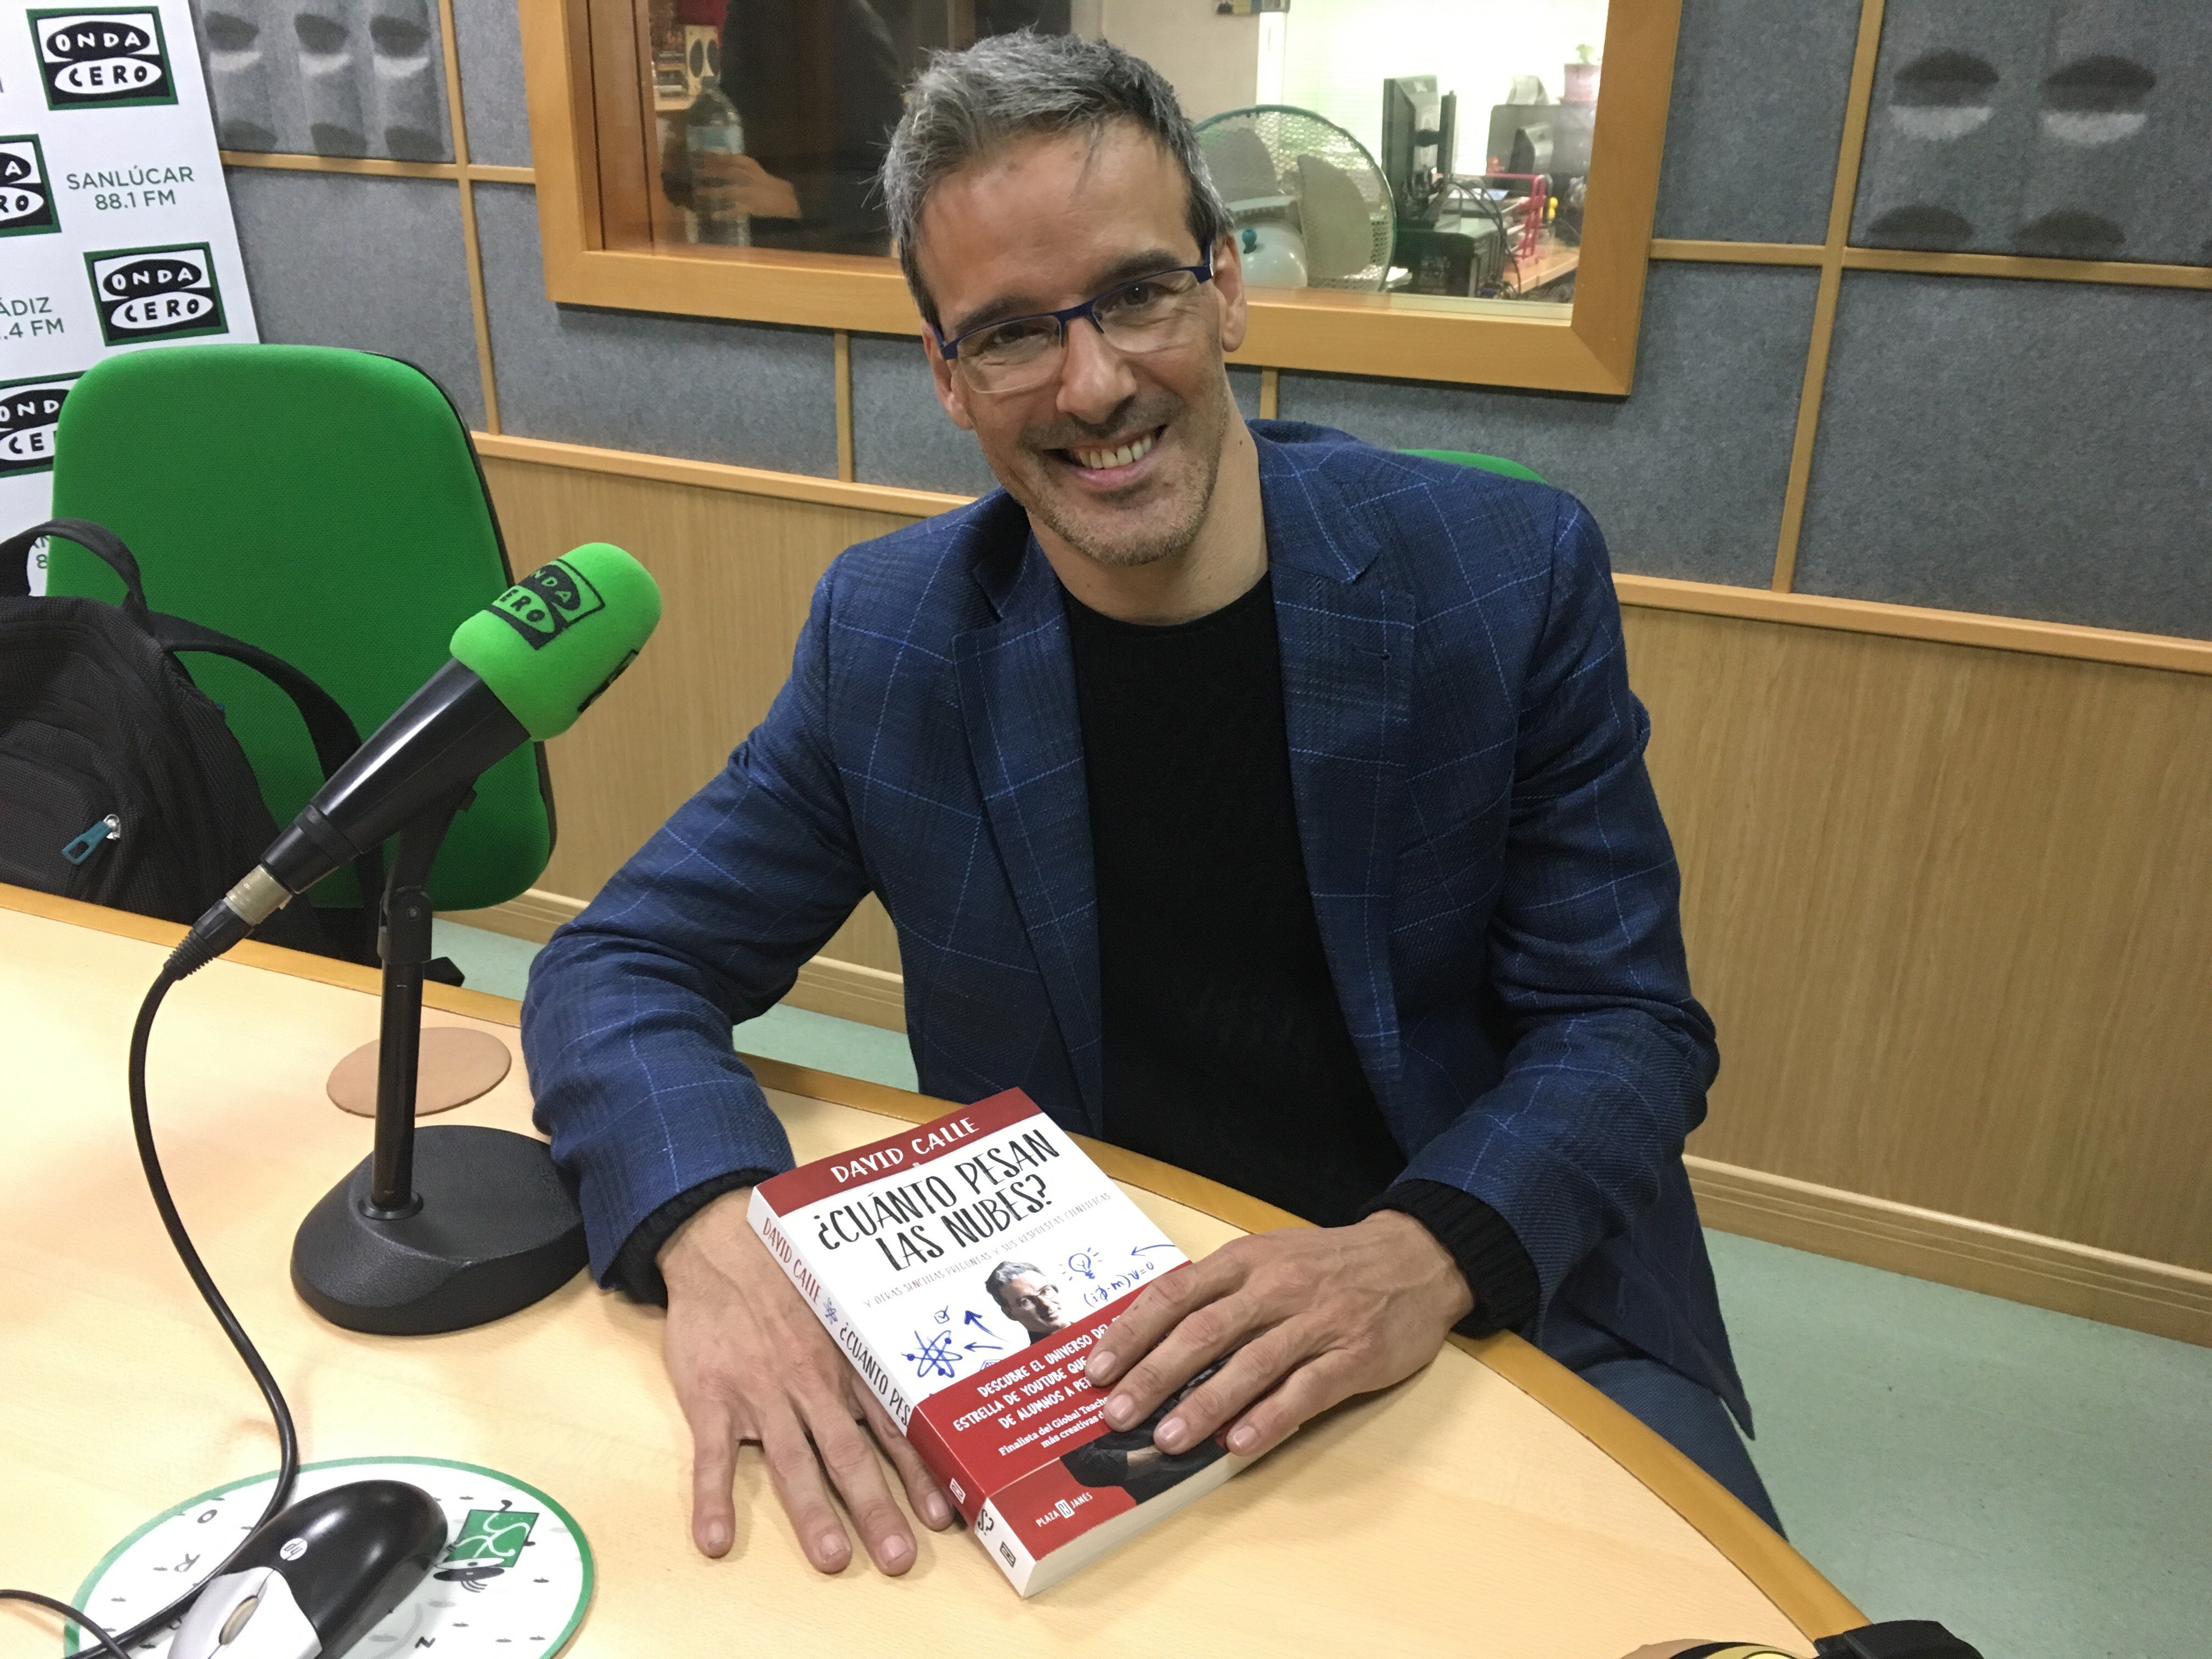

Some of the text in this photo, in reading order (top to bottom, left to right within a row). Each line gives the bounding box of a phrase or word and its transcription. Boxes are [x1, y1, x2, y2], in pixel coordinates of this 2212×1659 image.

[55, 32, 142, 52] ONDA
[69, 65, 148, 86] CERO
[66, 165, 194, 190] SANLÚCAR
[95, 190, 176, 210] 88.1 FM
[111, 264, 193, 290] ONDA
[0, 297, 52, 317] ÁDIZ
[124, 299, 200, 323] CERO
[31, 318, 64, 336] FM
[0, 400, 59, 422] OND
[9, 427, 57, 454] CE
[534, 570, 572, 603] NDA
[500, 589, 545, 622] ERO
[830, 1116, 979, 1183] DAVID CALLE
[814, 1129, 1060, 1250] ¿CUÁNTO PESAN
[875, 1173, 1052, 1271] LAS NUBES?
[1001, 1240, 1018, 1252] SUS
[763, 1217, 911, 1426] DAVID CALLE ¿CUÁNTO PES
[977, 1365, 1030, 1397] DESCUBRE
[1030, 1359, 1045, 1372] EL
[1044, 1335, 1092, 1364] UNIVERSO
[953, 1401, 1005, 1431] ESTRELLA
[1003, 1391, 1020, 1404] DE
[1020, 1368, 1067, 1396] YOUTUBE
[998, 1414, 1016, 1429] DE
[1016, 1390, 1064, 1420] ALUMNOS
[1064, 1386, 1075, 1397] A
[998, 1396, 1109, 1456] Finalista del Global Teache
[1041, 1433, 1060, 1448] más
[1059, 1415, 1099, 1438] creativas
[1035, 1510, 1060, 1527] PLAZA
[1070, 1492, 1093, 1508] JANÉS
